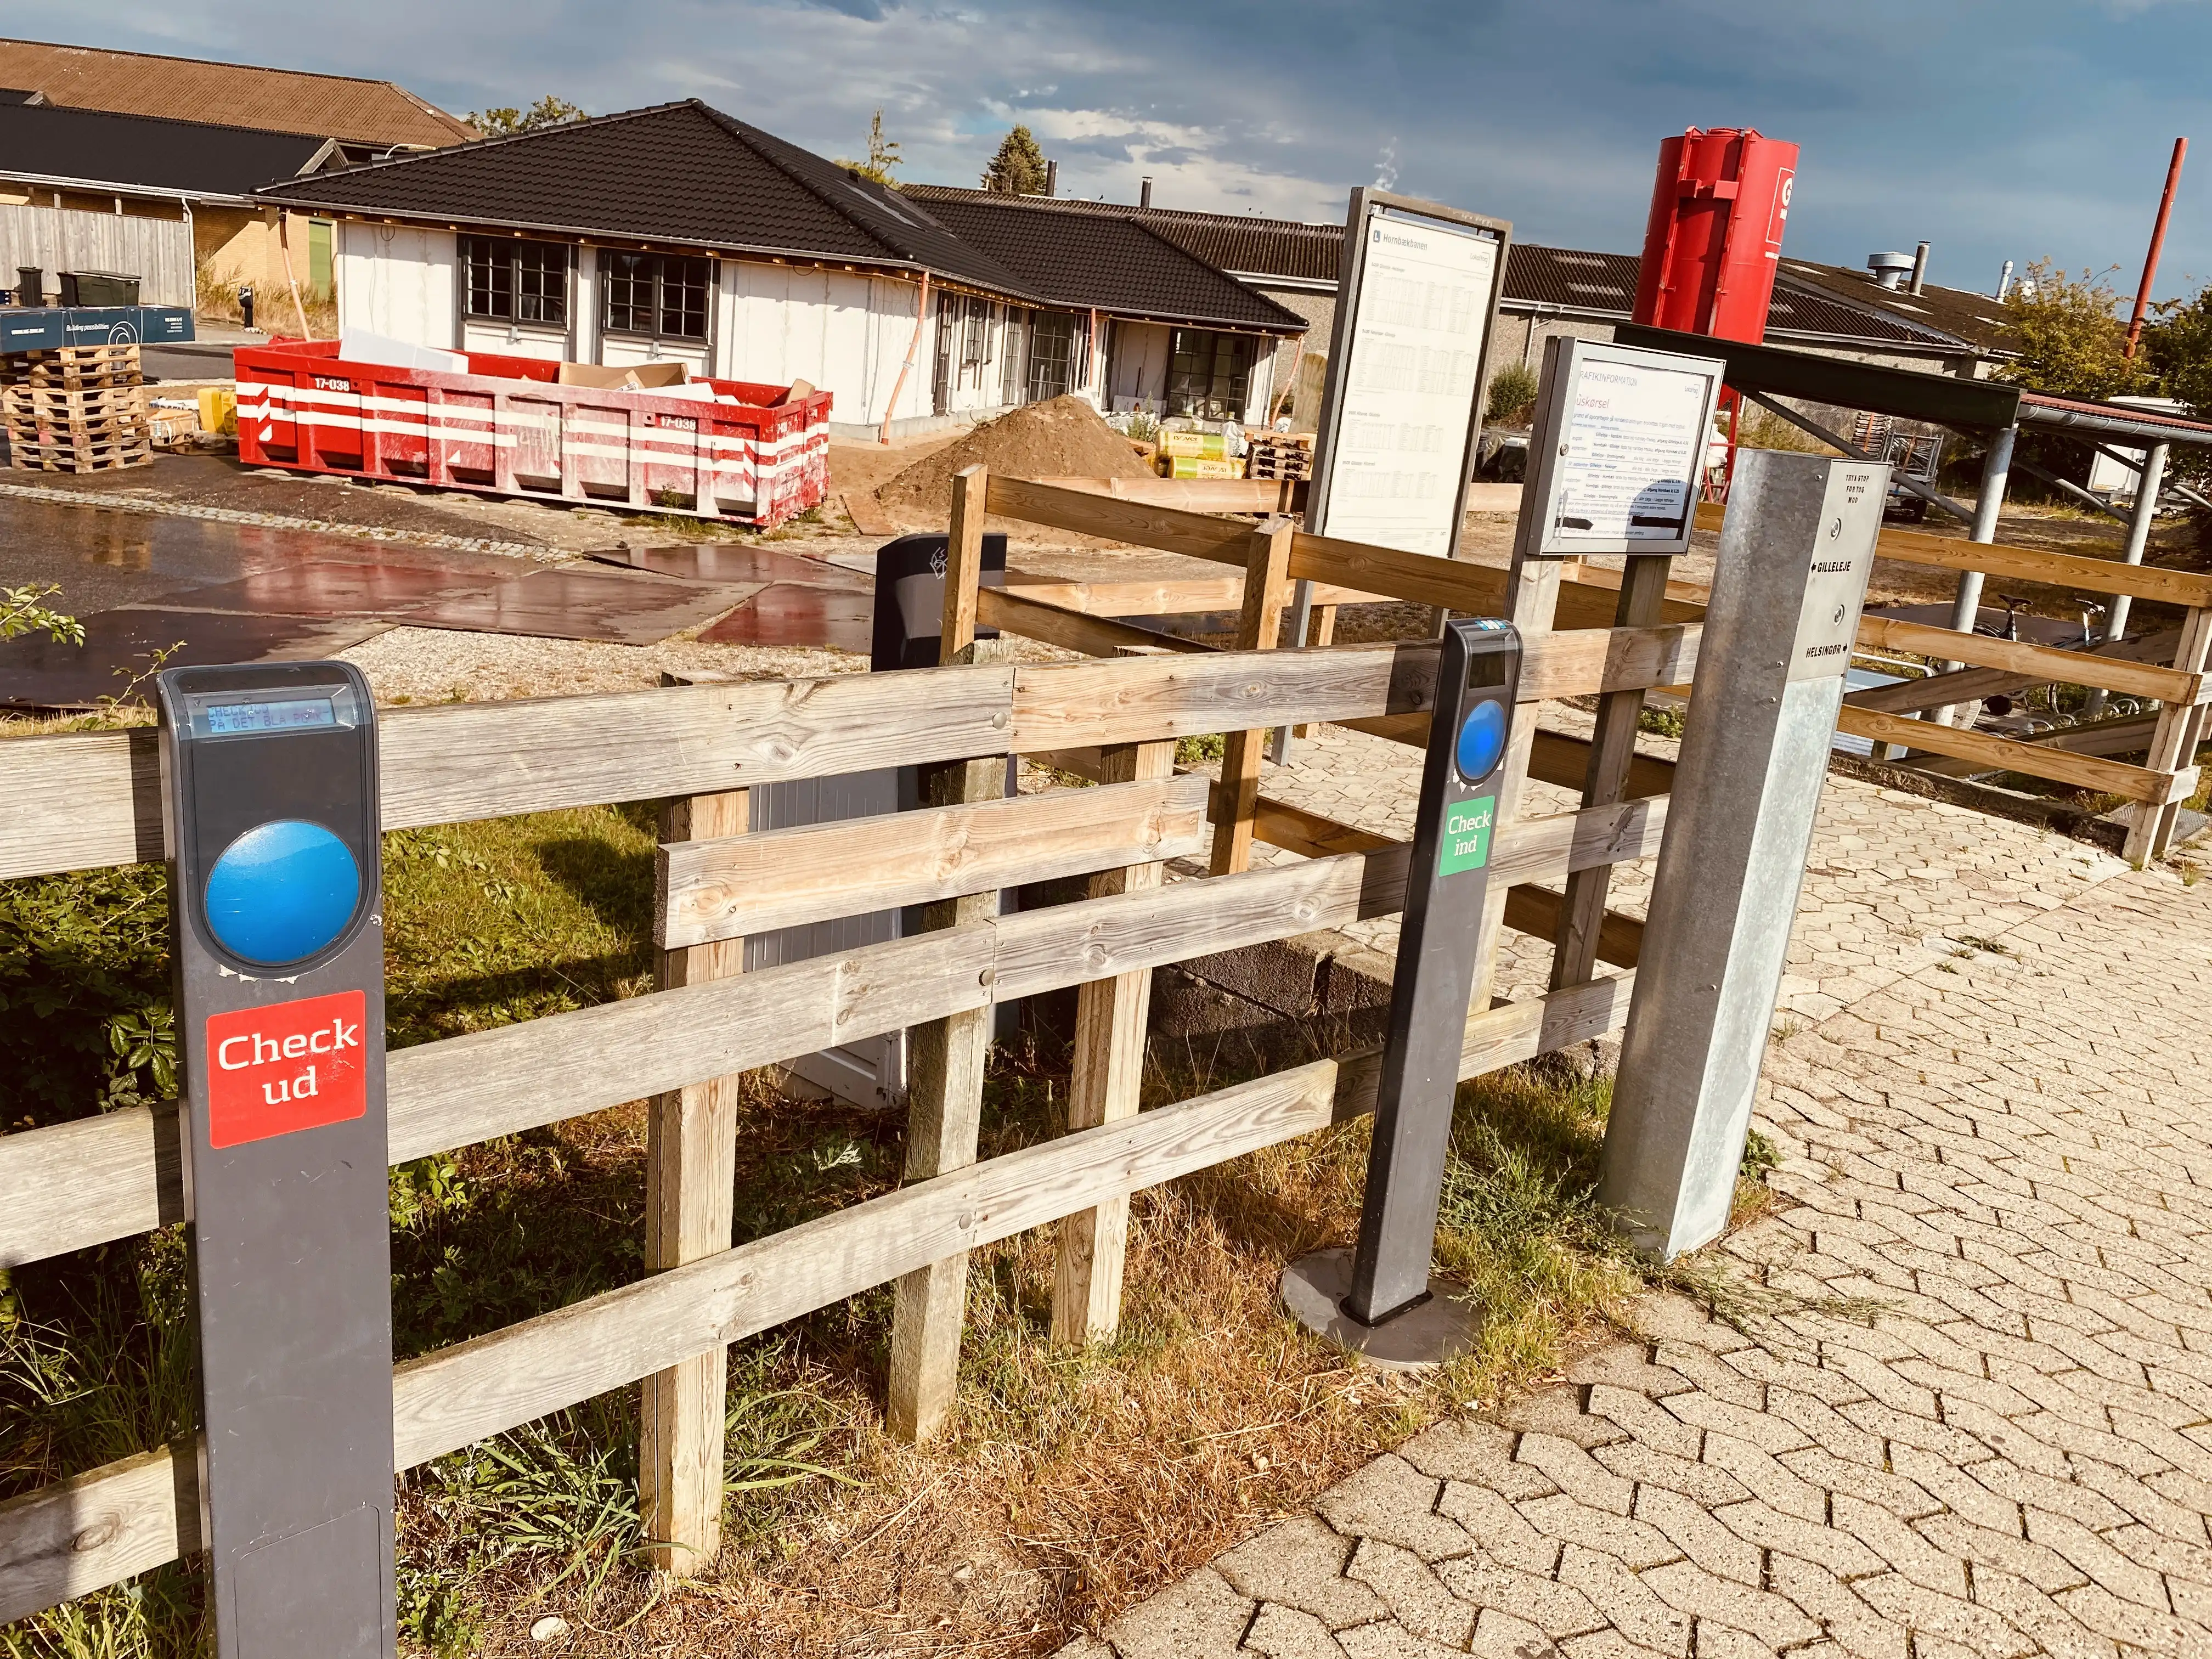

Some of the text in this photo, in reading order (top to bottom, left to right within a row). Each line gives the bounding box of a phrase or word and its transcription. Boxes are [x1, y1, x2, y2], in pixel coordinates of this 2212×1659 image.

[1383, 233, 1427, 251] Hornbækbanen
[315, 377, 350, 392] 17-038
[1579, 370, 1638, 386] RAFIKINFORMATION
[1576, 396, 1610, 409] uskørsel
[660, 415, 696, 431] 17-038
[1817, 561, 1852, 573] GILLELEJE
[1806, 644, 1842, 658] HELSINGØR
[233, 716, 255, 729] DET
[1448, 810, 1491, 834] Check
[1454, 835, 1478, 856] ind
[218, 1018, 359, 1070] Check
[262, 1065, 319, 1105] ud
